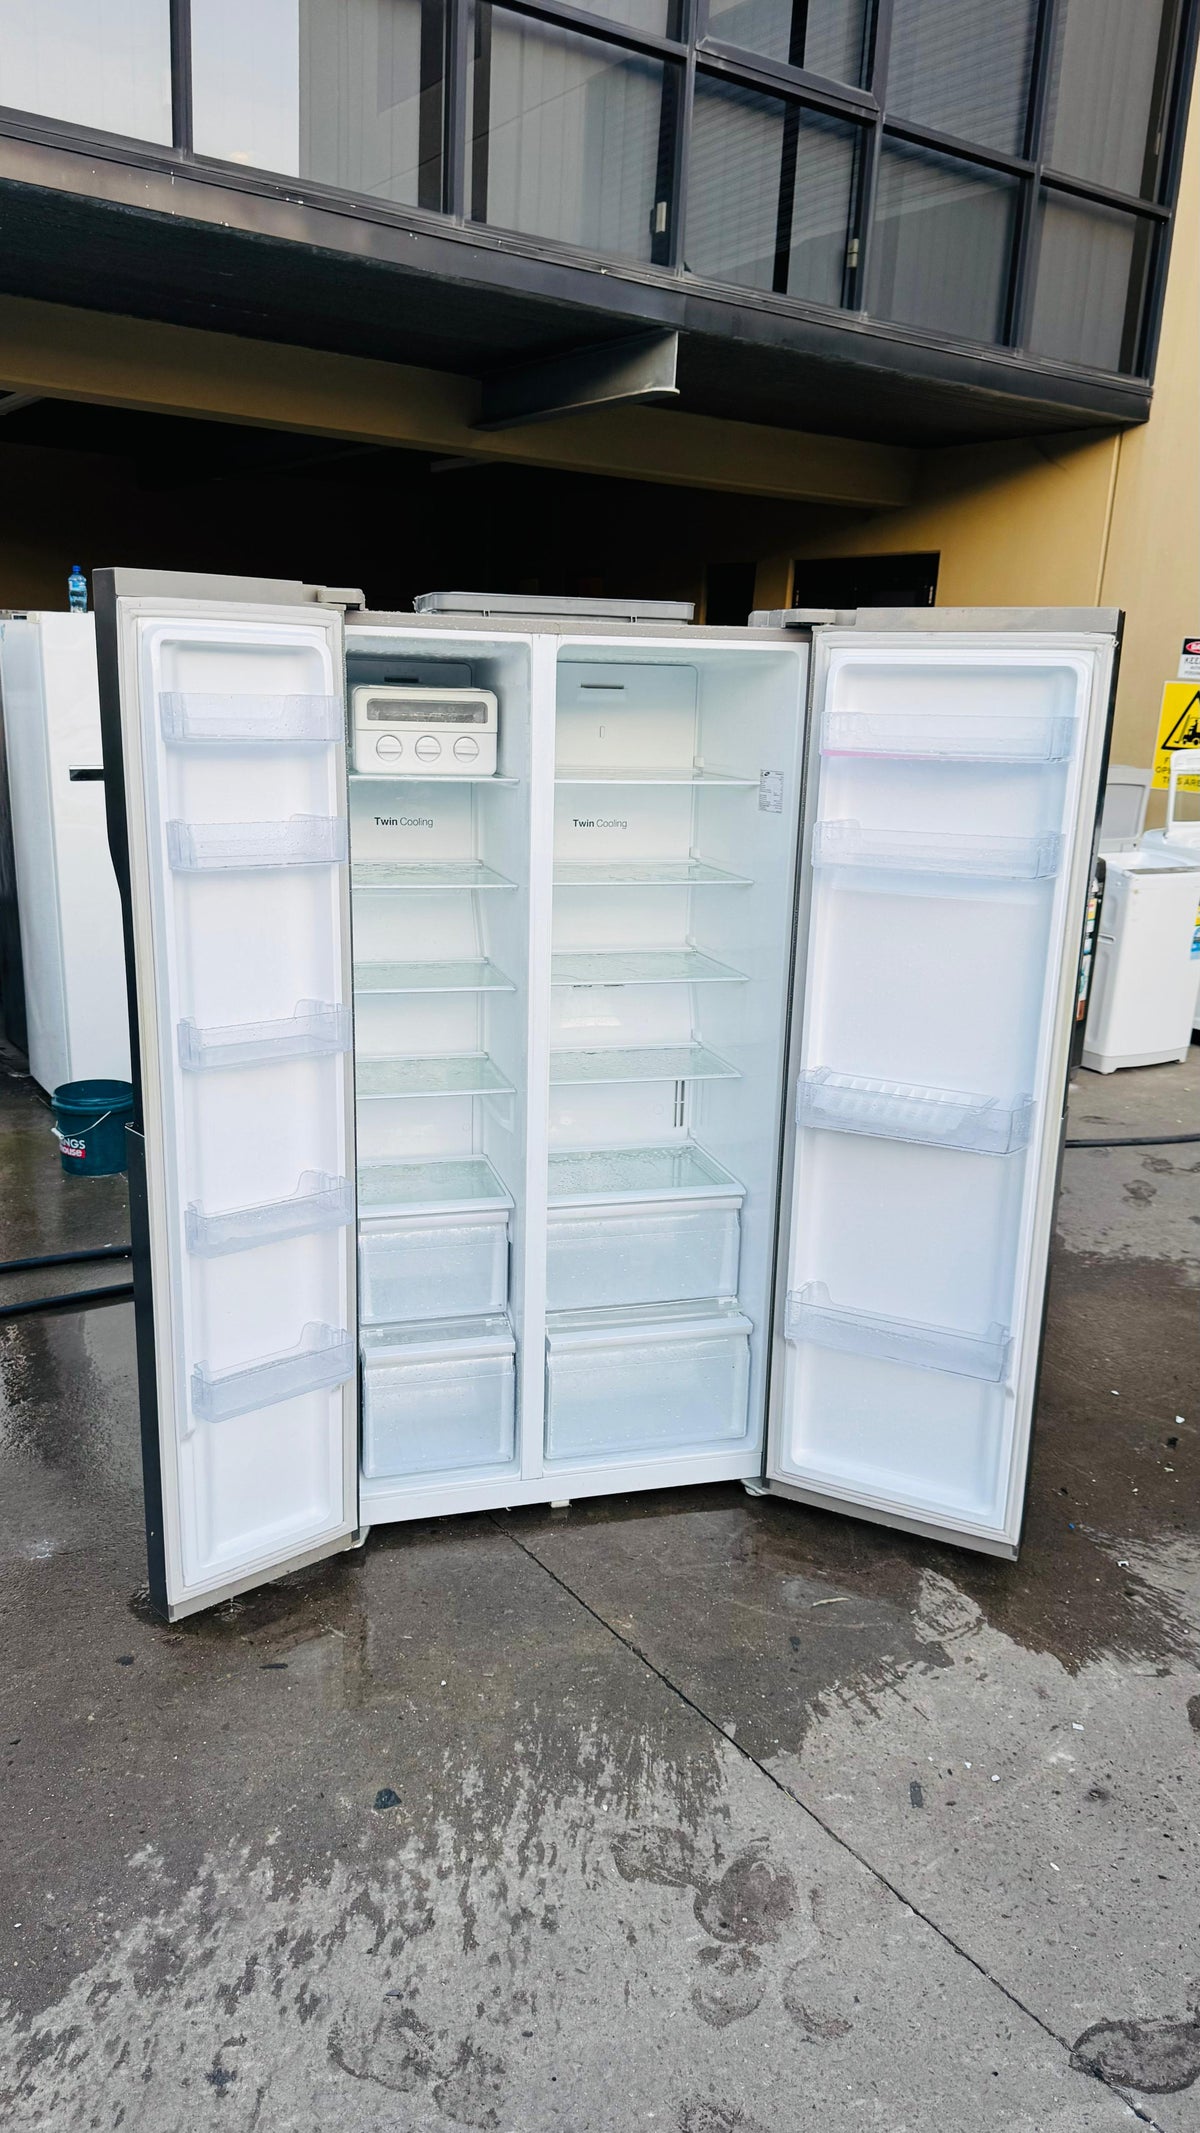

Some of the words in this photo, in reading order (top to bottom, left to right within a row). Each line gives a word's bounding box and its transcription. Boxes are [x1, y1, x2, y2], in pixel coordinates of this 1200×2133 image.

[374, 816, 398, 826] Twin
[399, 816, 434, 829] Cooling
[573, 819, 595, 828] Twin
[596, 819, 628, 830] Cooling
